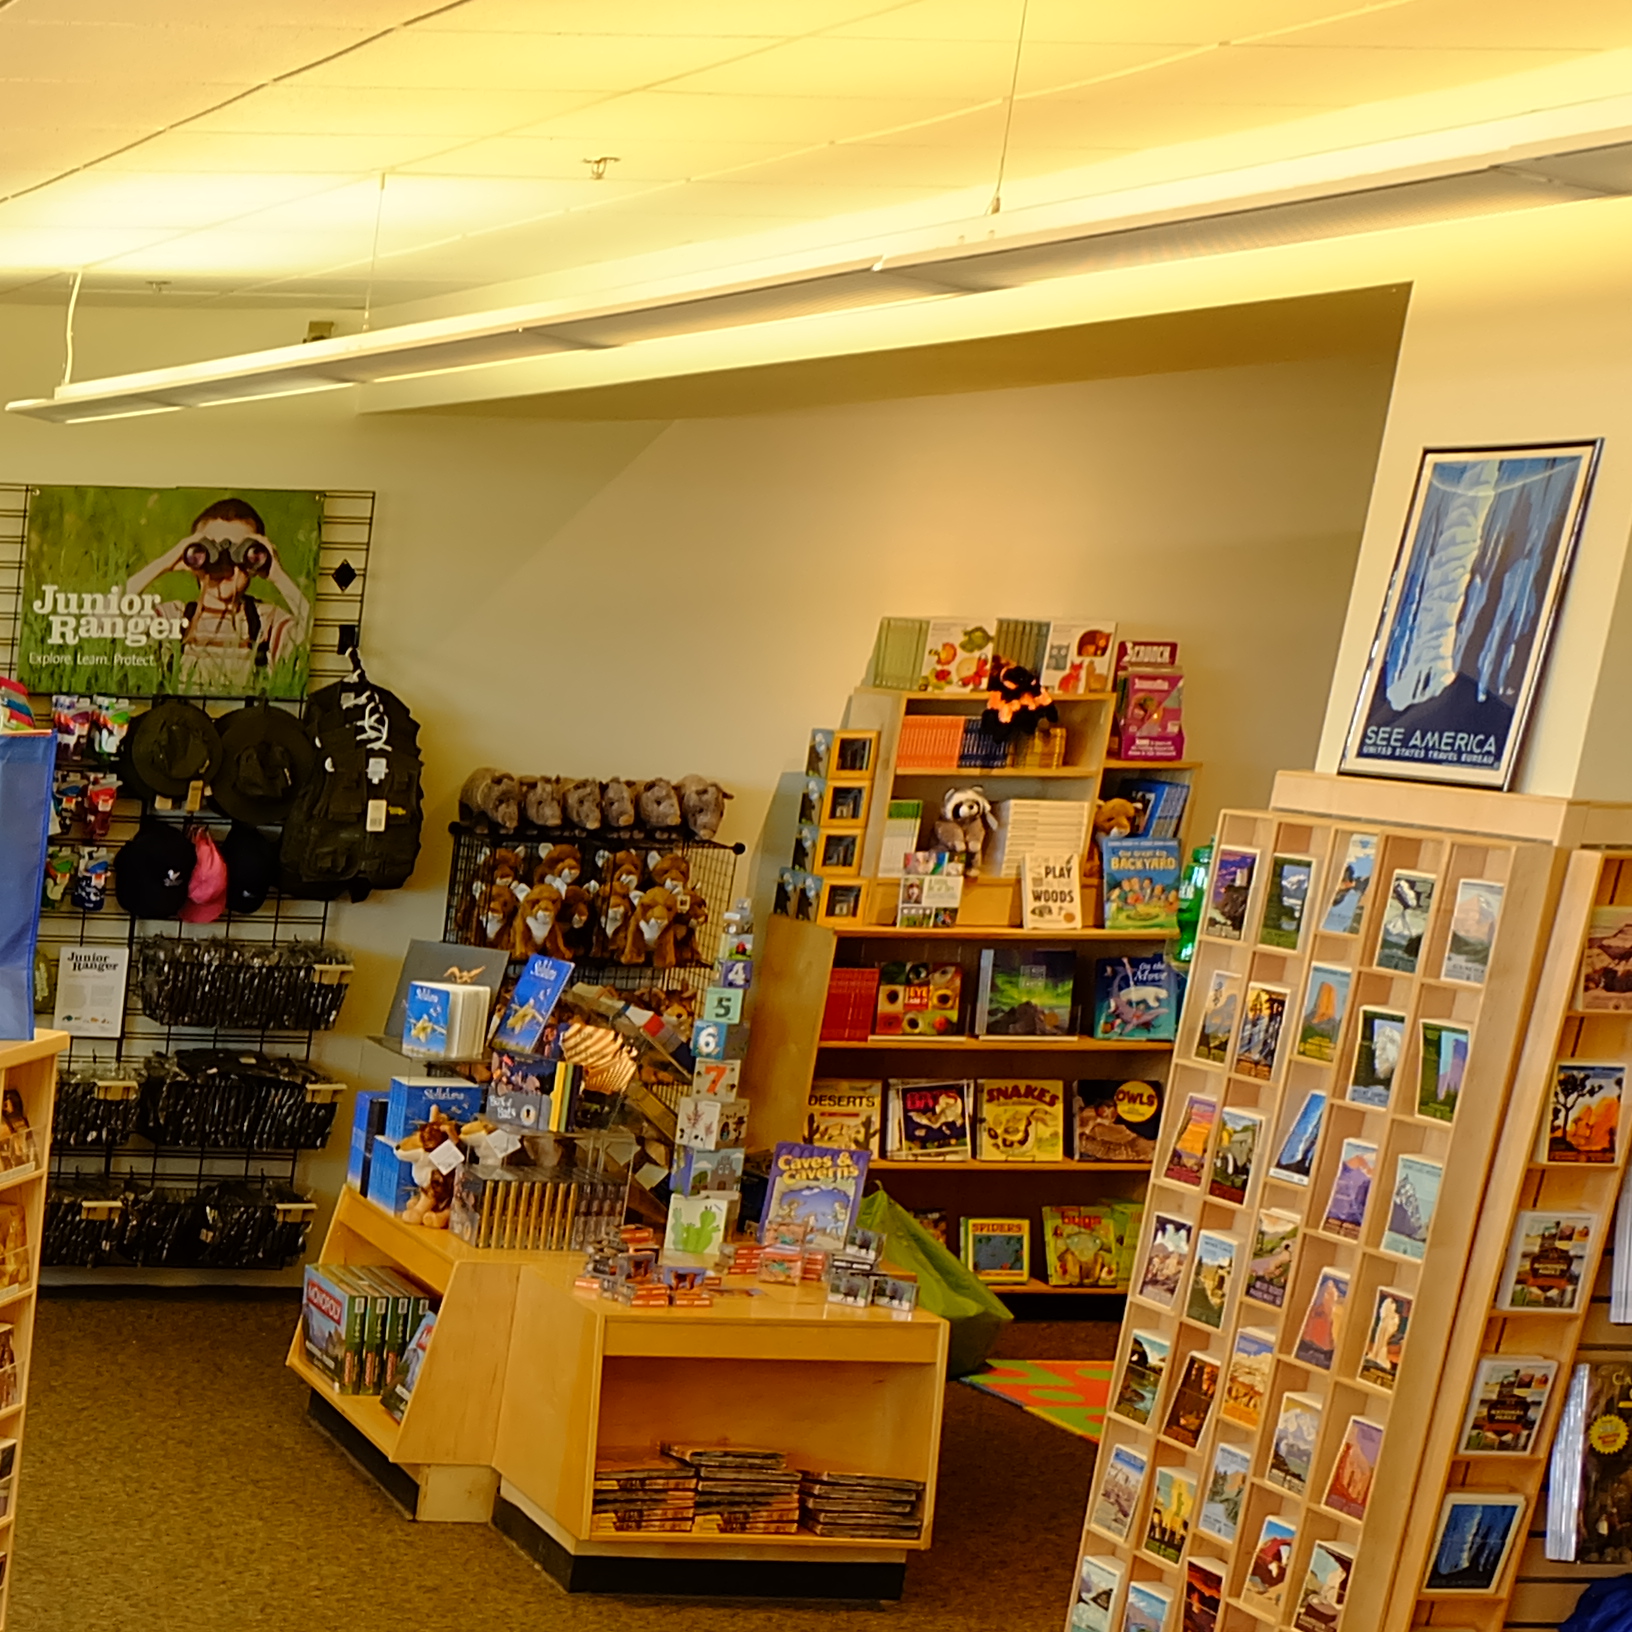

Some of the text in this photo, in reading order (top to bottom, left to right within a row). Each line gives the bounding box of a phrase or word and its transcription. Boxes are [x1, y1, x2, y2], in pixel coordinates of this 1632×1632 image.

[33, 584, 161, 616] Junior
[47, 615, 189, 647] Ranger
[1364, 726, 1496, 754] SEE AMERICA
[1363, 745, 1495, 764] UNITED STATES TRAVEL BUREAU
[1044, 865, 1073, 880] PLAY
[1111, 857, 1176, 870] BACKYARD
[1031, 889, 1074, 903] WOODS
[67, 952, 110, 963] Junior
[72, 961, 119, 972] Ranger
[728, 962, 745, 985] 4
[1134, 970, 1168, 982] Move
[715, 997, 732, 1018] 5
[698, 1026, 719, 1055] 6
[704, 1065, 728, 1094] 7
[807, 1093, 876, 1108] DESERTS
[986, 1085, 1059, 1108] SNAKES
[1115, 1088, 1155, 1107] OWLS
[777, 1153, 853, 1171] Caves &
[972, 1222, 1023, 1233] SPIDERS
[1061, 1213, 1101, 1229] bugs
[308, 1284, 341, 1321] MONOPOLY
